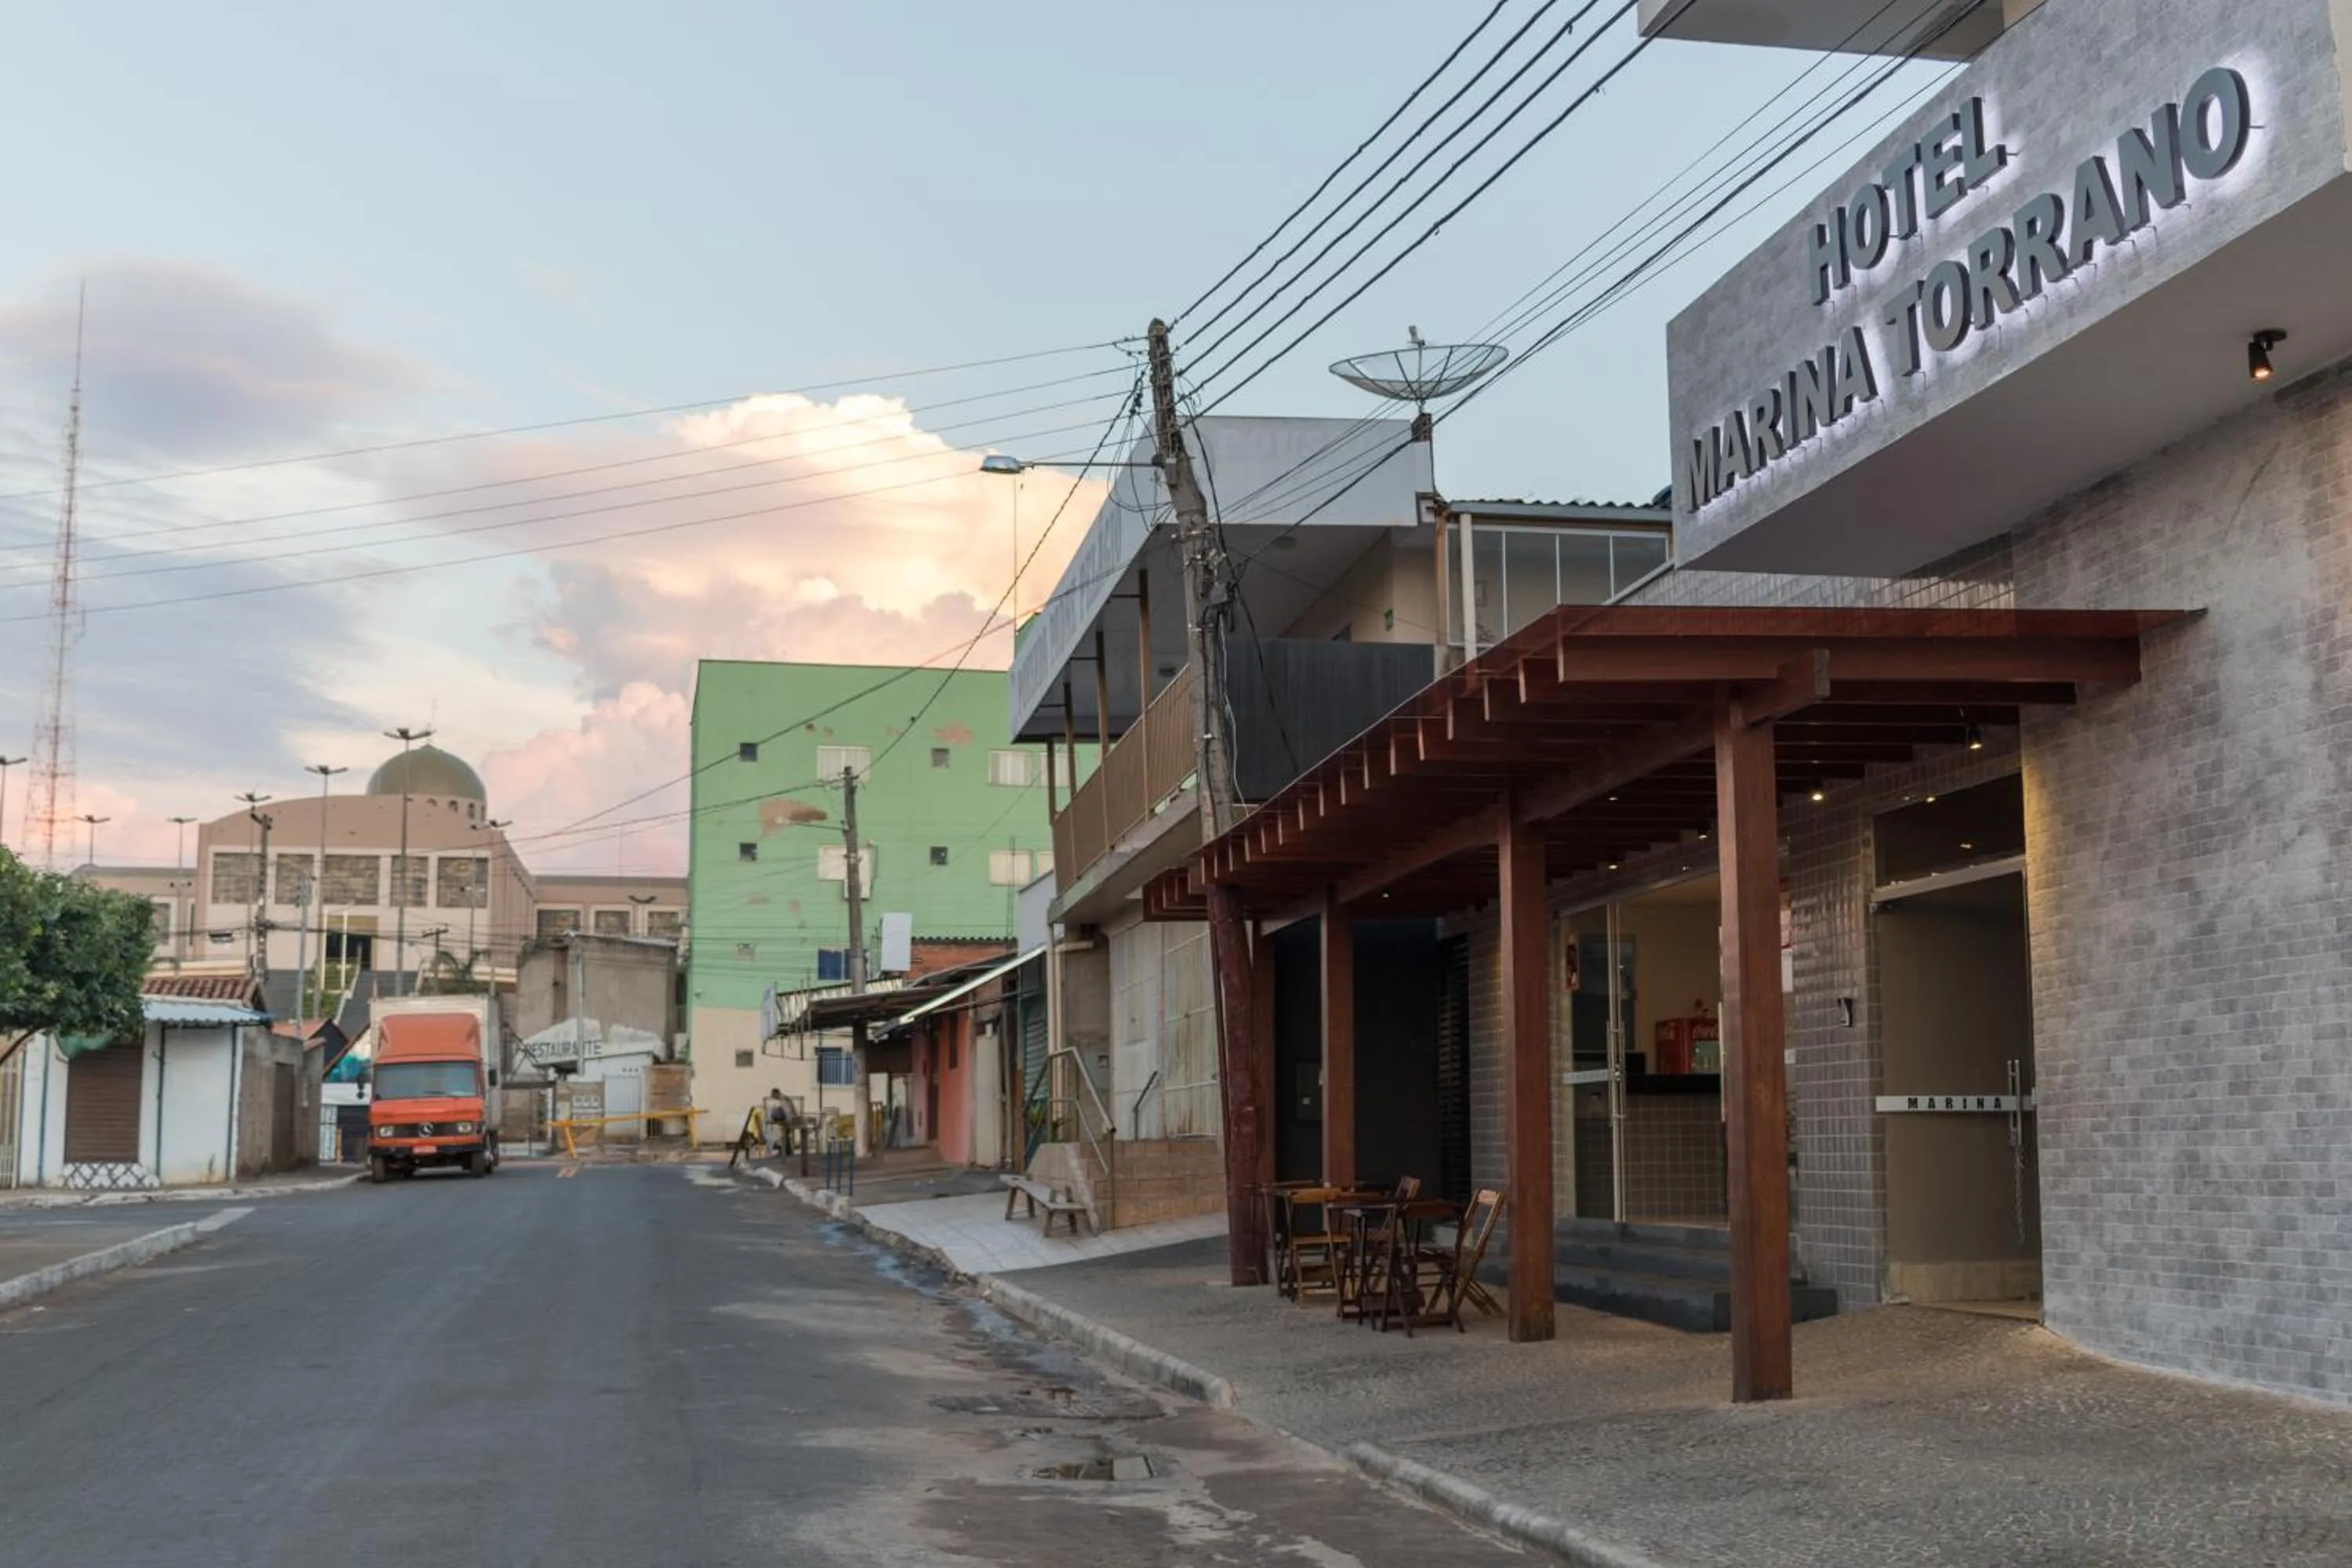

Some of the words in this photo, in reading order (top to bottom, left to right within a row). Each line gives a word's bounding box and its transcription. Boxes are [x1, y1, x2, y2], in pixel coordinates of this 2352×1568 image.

[1686, 326, 1878, 514] MARINA
[1883, 67, 2251, 376] TORRANO
[1808, 96, 2007, 305] HOTEL
[1907, 1097, 2002, 1109] MARINA
